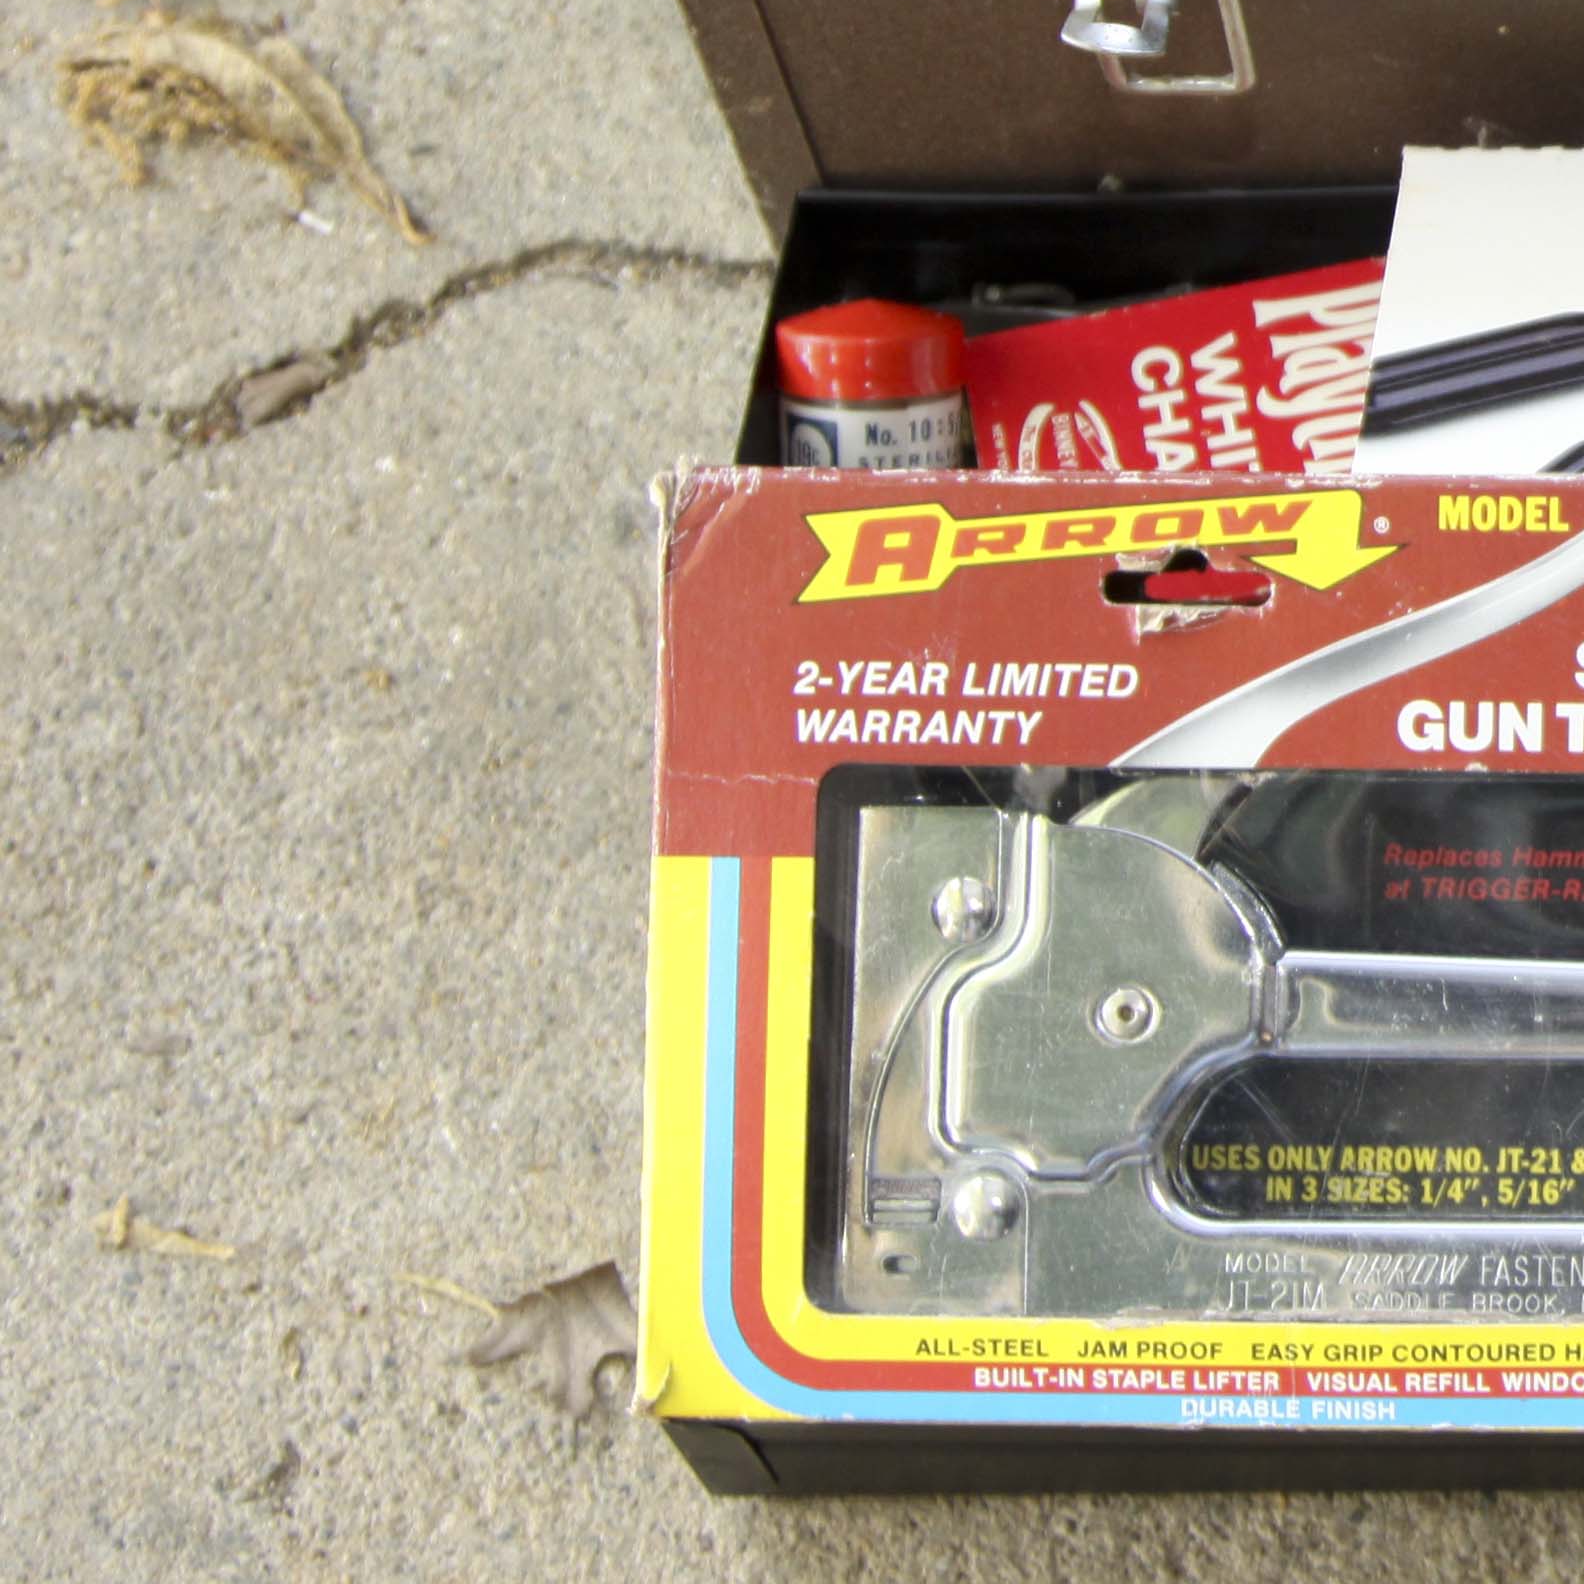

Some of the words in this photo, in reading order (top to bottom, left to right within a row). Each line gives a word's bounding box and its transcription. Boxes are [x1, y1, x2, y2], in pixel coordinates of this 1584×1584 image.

[1438, 495, 1570, 533] MODEL
[845, 500, 1313, 587] ARROW
[793, 661, 948, 697] 2-YEAR
[961, 663, 1139, 698] LIMITED
[796, 709, 1044, 745] WARRANTY
[1396, 699, 1546, 752] GUN
[1384, 842, 1502, 871] Replaces
[1385, 879, 1411, 899] at
[1192, 1144, 1261, 1170] USES
[1268, 1145, 1334, 1171] ONLY
[1341, 1145, 1438, 1172] ARROW
[1446, 1146, 1489, 1173] NO.
[1496, 1147, 1562, 1174] JT-21
[1266, 1176, 1293, 1202] IN
[1302, 1177, 1318, 1202] 3
[1327, 1177, 1410, 1204] SIZES:
[1497, 1178, 1575, 1208] 5/16"
[1225, 1252, 1316, 1273] MODEL
[1339, 1253, 1470, 1286] ARROW
[1353, 1291, 1457, 1314] SADDLE
[916, 1337, 1050, 1358] ALL-STEEL
[1077, 1340, 1128, 1359] JAM
[1137, 1342, 1224, 1360] PROOF
[1250, 1342, 1315, 1362] EASY
[1323, 1343, 1384, 1363] GRIP
[1392, 1344, 1557, 1363] CONTOURED
[974, 1367, 1085, 1389] BUILT-IN
[1092, 1368, 1187, 1390] STAPLE
[1193, 1371, 1281, 1392] LIFTER
[1307, 1372, 1398, 1394] VISUAL
[1404, 1372, 1491, 1394] REFILL
[1181, 1398, 1301, 1420] DURABLE
[1312, 1400, 1396, 1420] FINISH
